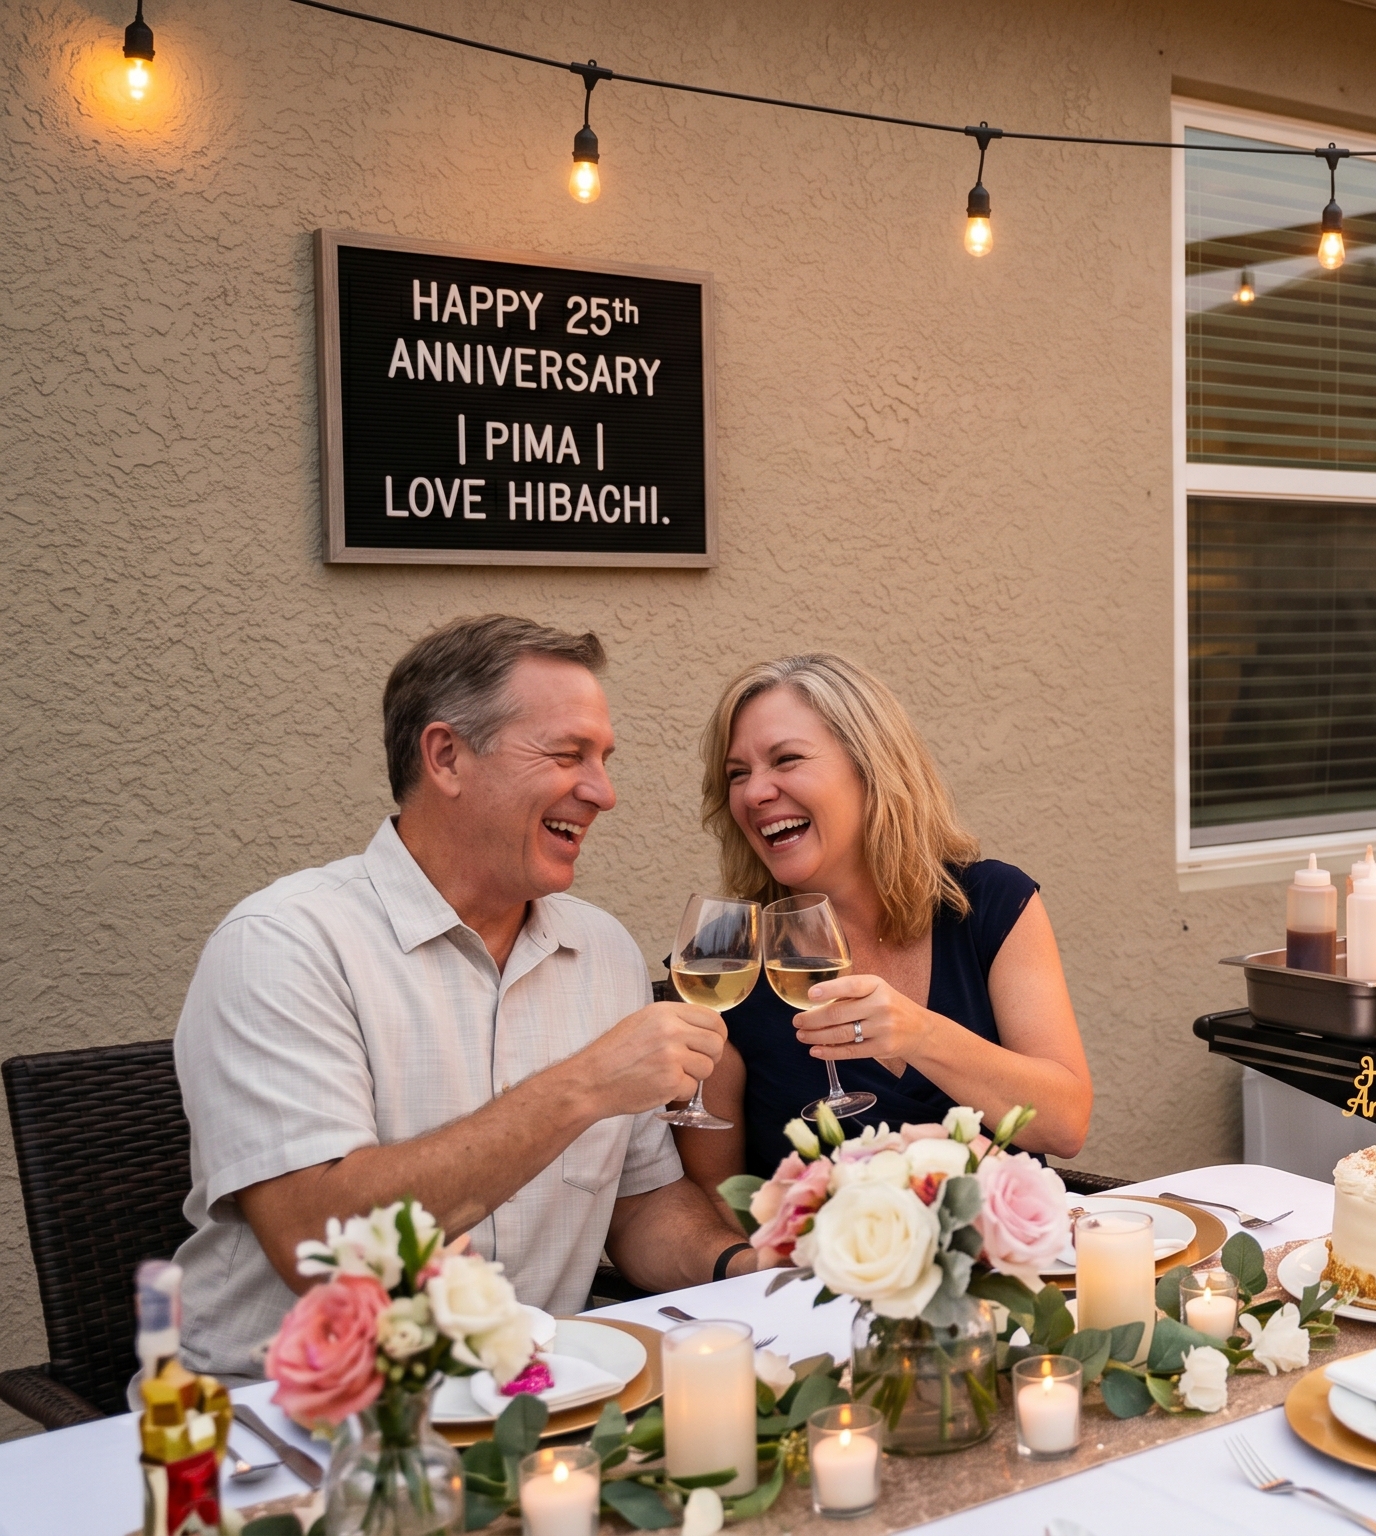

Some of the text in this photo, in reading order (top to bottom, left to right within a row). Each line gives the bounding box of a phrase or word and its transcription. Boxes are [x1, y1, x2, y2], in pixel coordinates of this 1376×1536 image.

[412, 279, 639, 337] HAPPY 25th
[387, 337, 661, 397] ANNIVERSARY
[485, 421, 581, 466] PIMA
[385, 475, 671, 526] LOVE HIBACHI.
